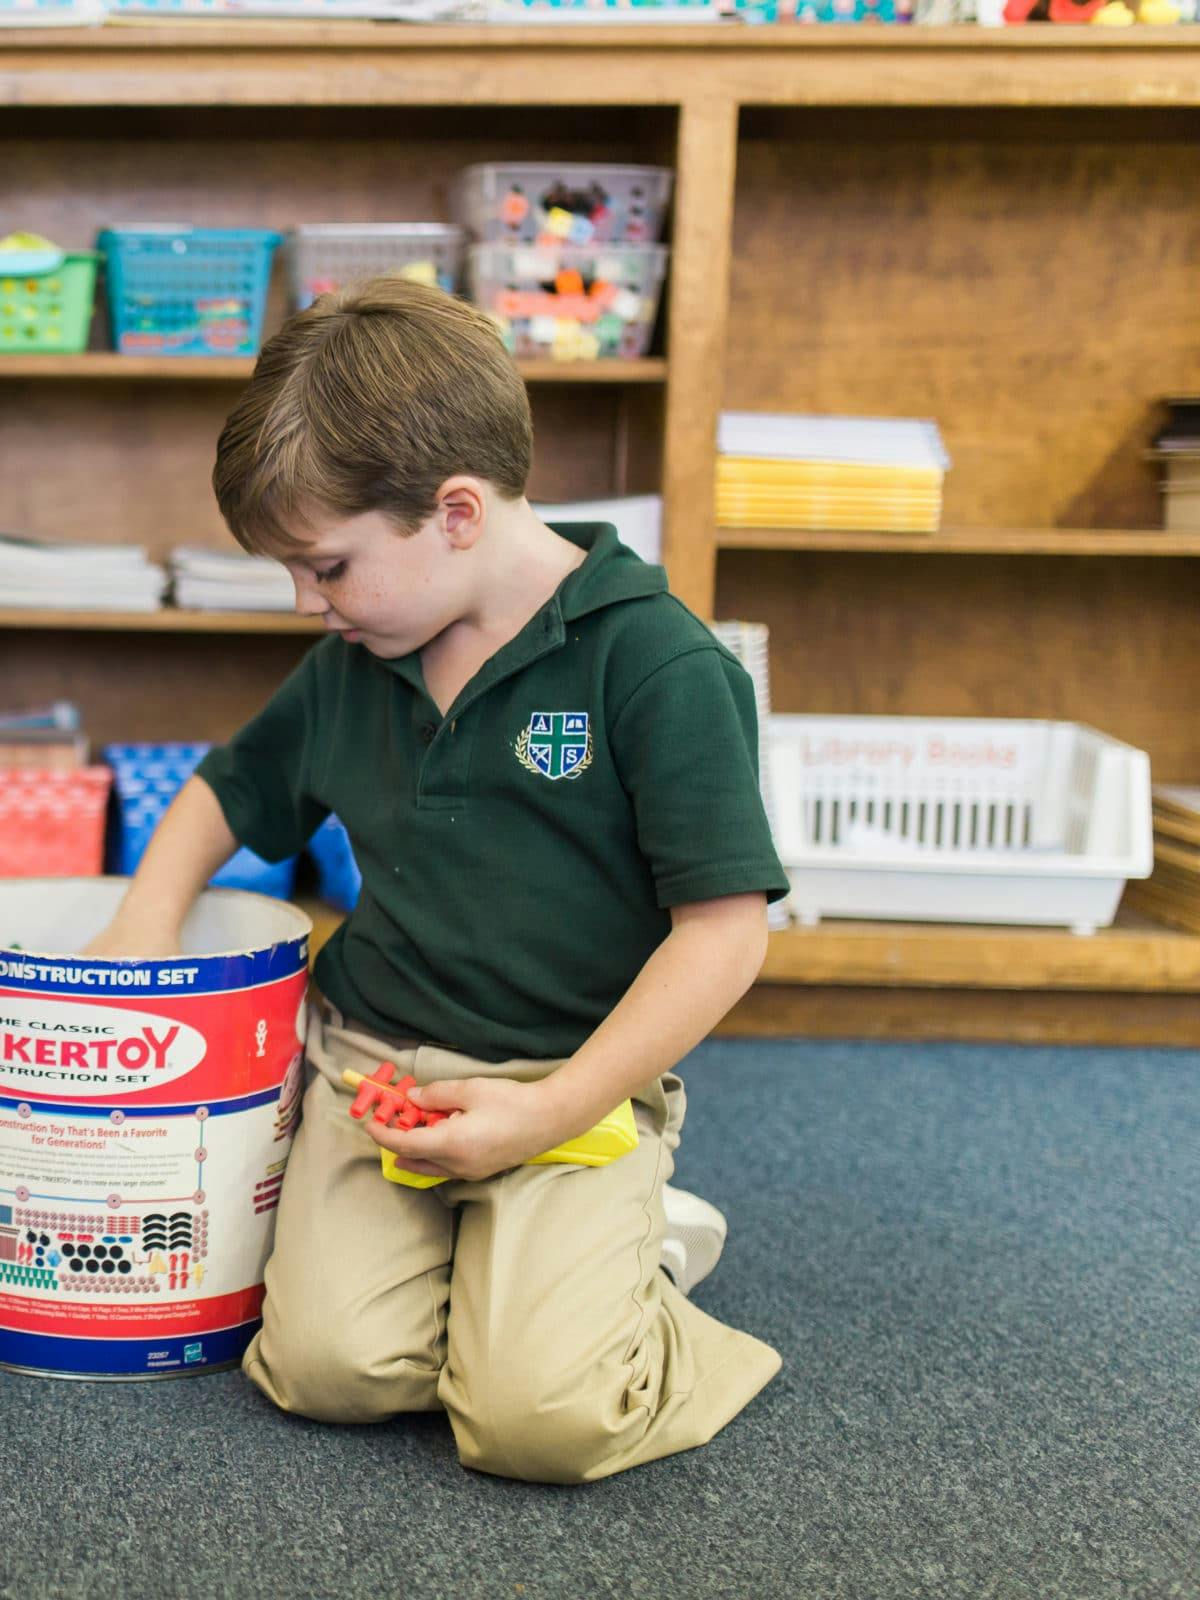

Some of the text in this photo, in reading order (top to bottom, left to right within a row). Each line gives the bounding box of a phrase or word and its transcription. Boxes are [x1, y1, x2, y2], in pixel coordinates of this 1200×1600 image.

[534, 716, 547, 731] A
[566, 749, 578, 764] S
[156, 967, 199, 986] SET
[28, 1021, 115, 1034] CLASSIC
[115, 1074, 150, 1083] SET
[50, 1124, 65, 1136] Toy
[68, 1126, 95, 1137] That's
[97, 1128, 120, 1137] Been
[131, 1128, 168, 1137] Favorite
[31, 1134, 106, 1149] for Generations!
